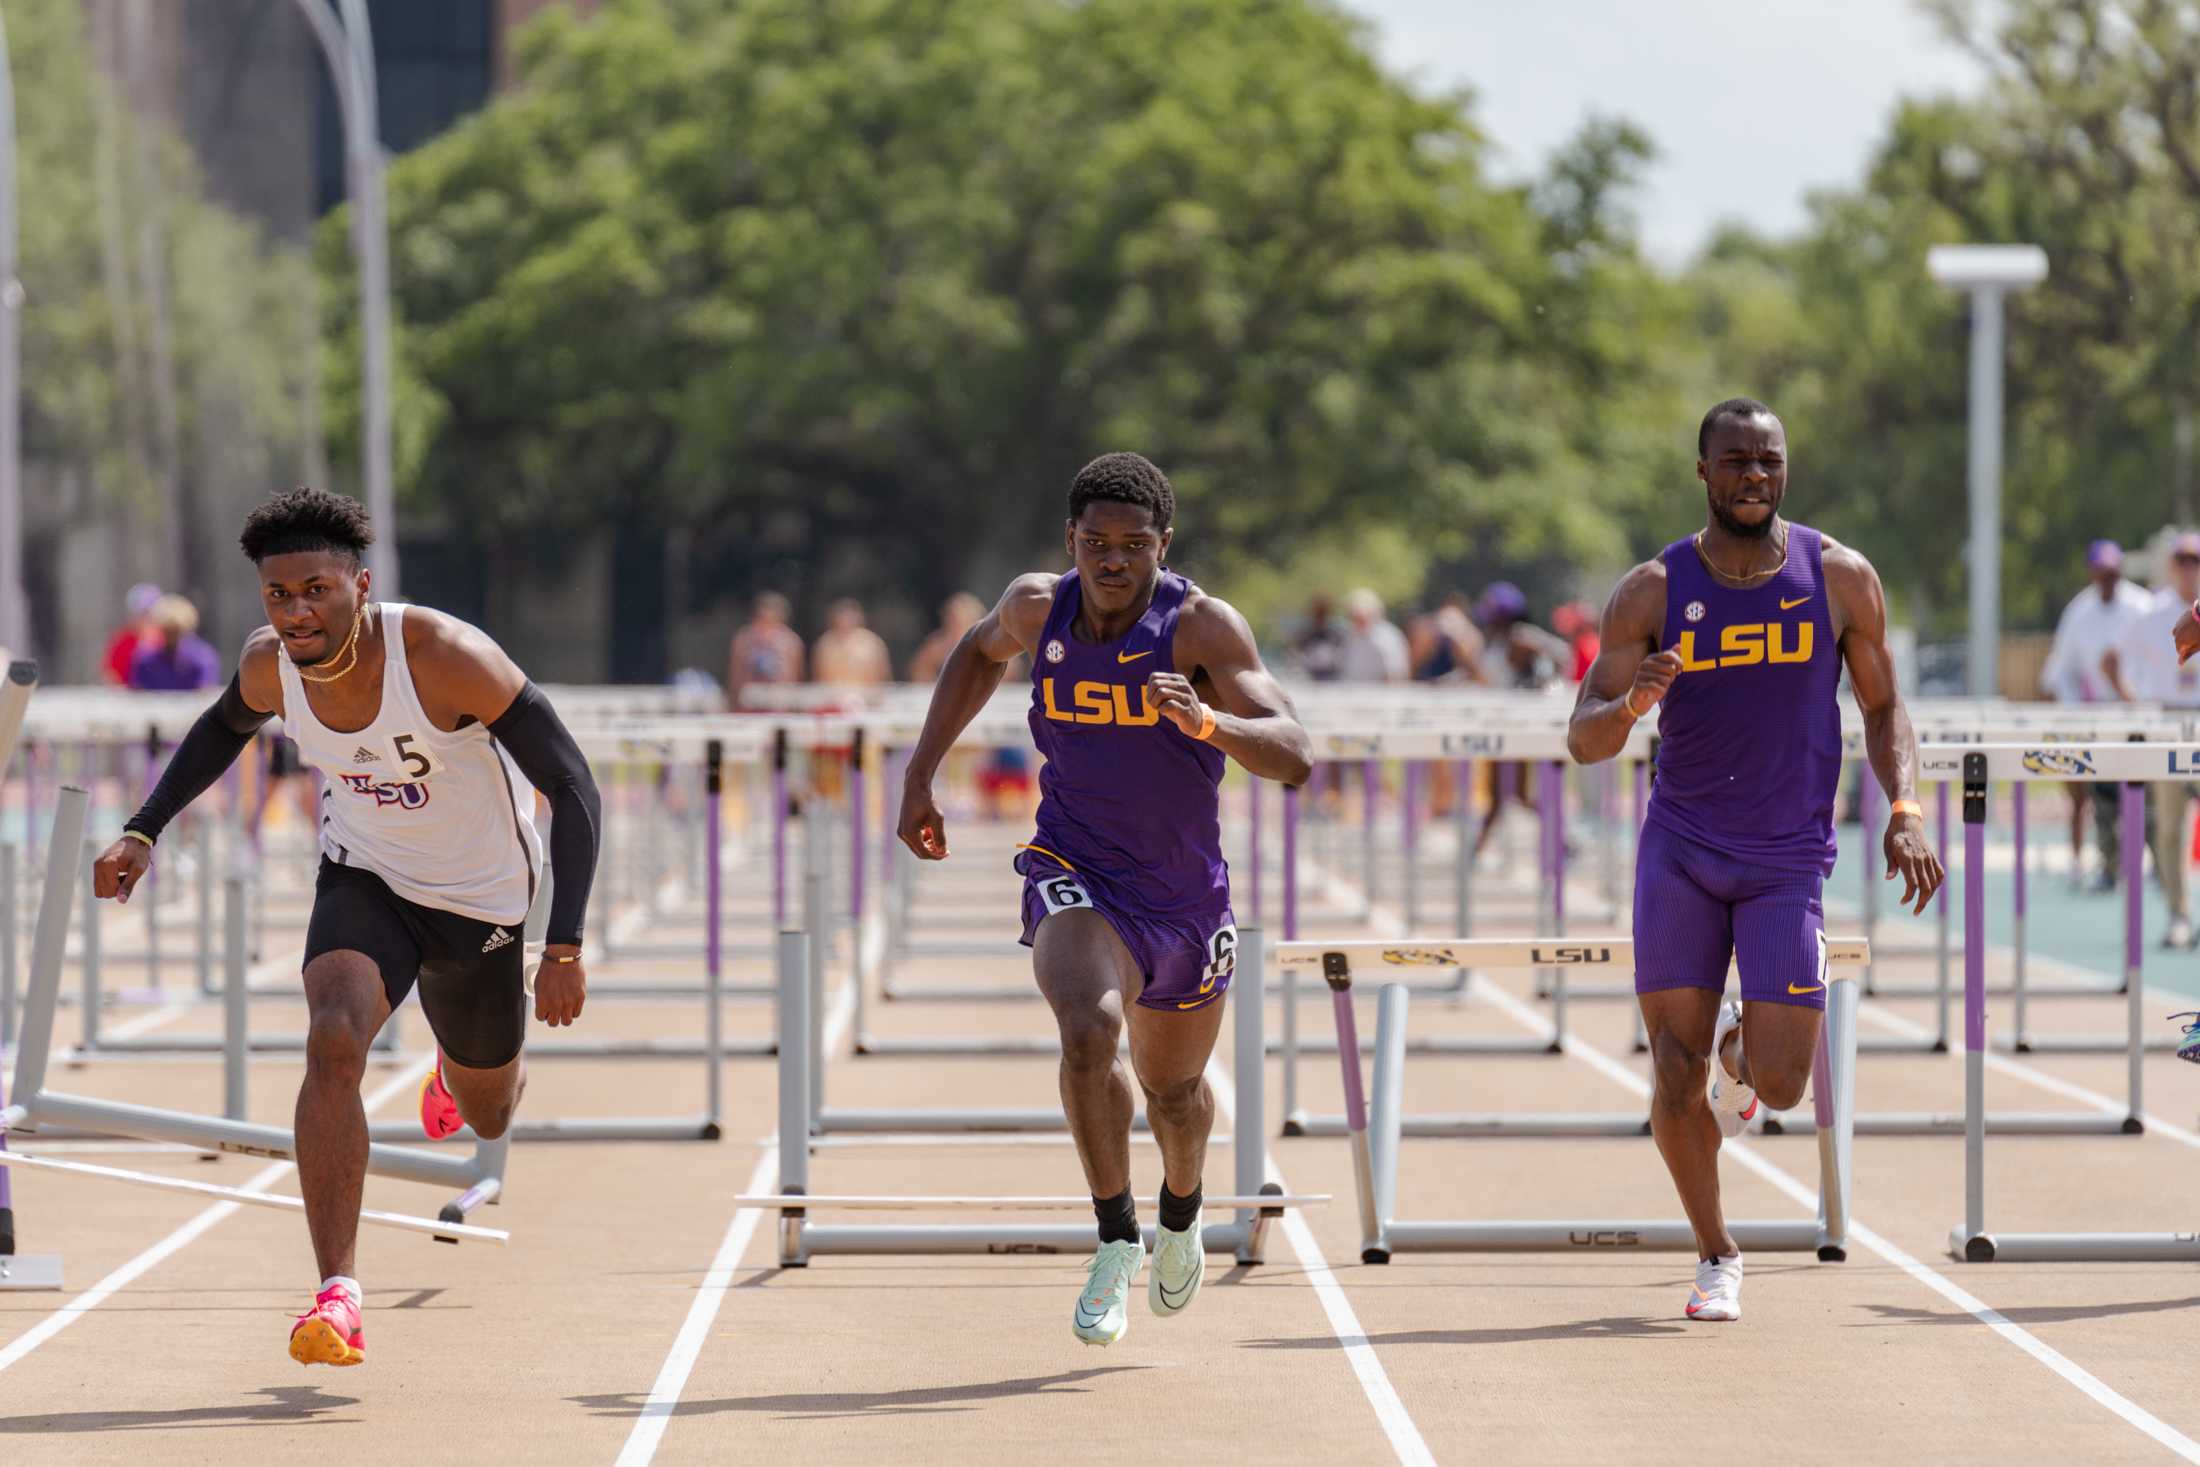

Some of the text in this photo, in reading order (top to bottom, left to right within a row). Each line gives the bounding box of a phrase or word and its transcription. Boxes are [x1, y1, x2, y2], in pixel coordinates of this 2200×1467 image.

[1680, 622, 1814, 672] LSU
[1043, 678, 1160, 726] LSU
[393, 734, 431, 778] 5
[1922, 761, 1960, 770] UCS
[1046, 879, 1083, 906] 6
[1210, 930, 1234, 976] 6
[1531, 948, 1611, 963] LSU
[1569, 1231, 1639, 1246] UCS
